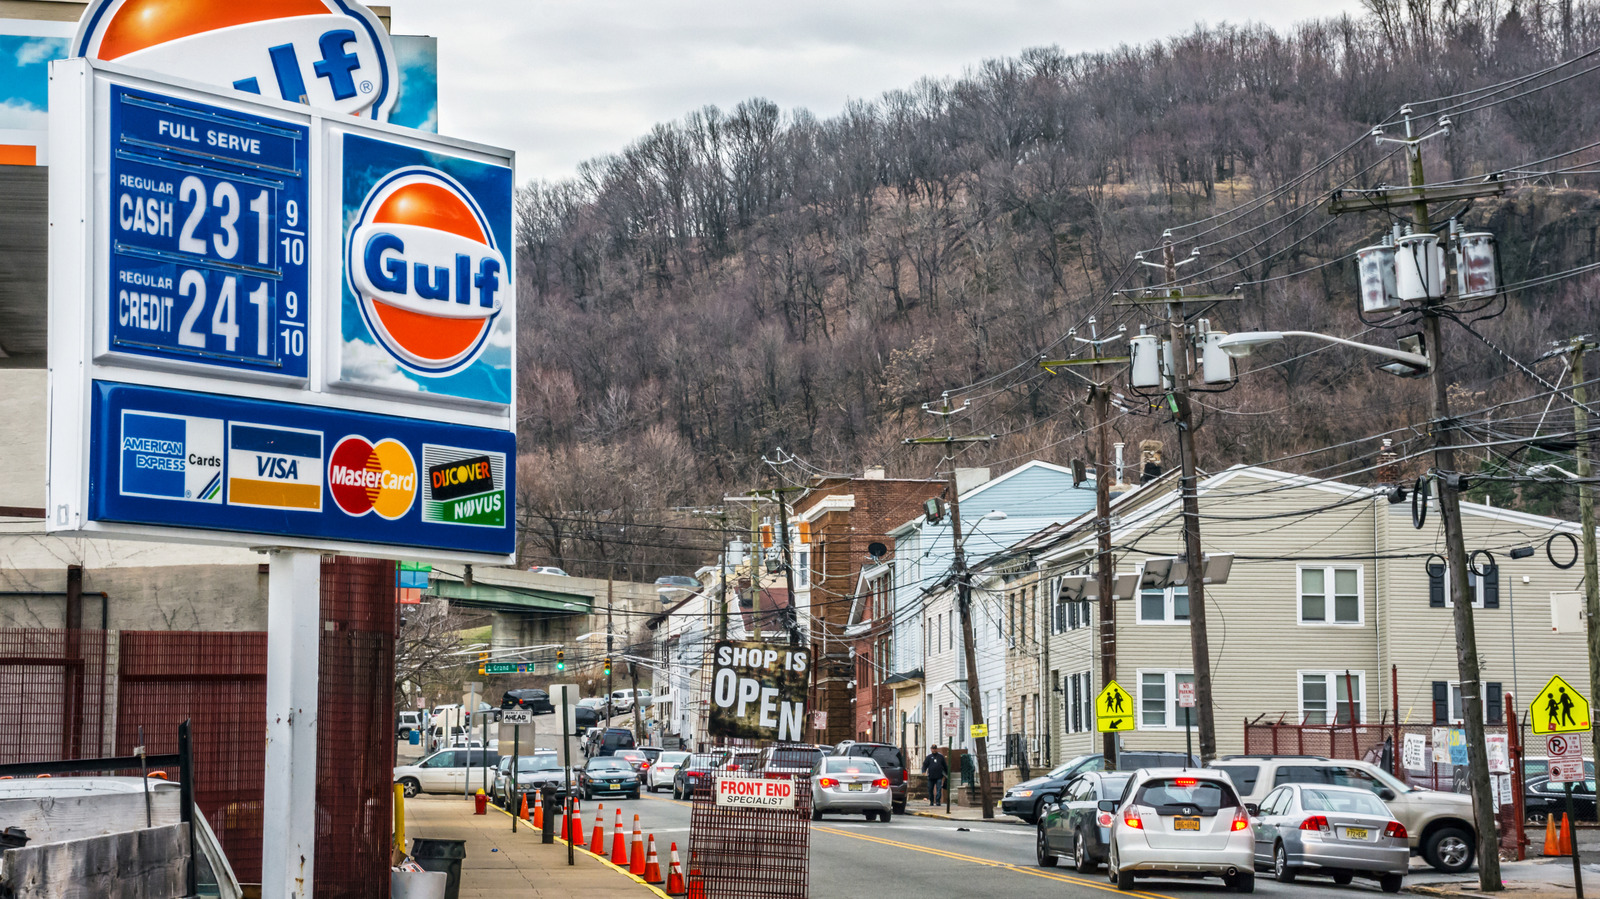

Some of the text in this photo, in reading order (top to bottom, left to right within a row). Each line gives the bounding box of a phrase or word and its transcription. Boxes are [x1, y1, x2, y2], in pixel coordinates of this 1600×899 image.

[233, 29, 361, 104] lf
[158, 119, 261, 155] FULL SERVE
[120, 174, 174, 195] REGULAR
[120, 193, 174, 238] CASH
[178, 175, 269, 265] 231
[119, 270, 173, 290] REGULAR
[363, 232, 500, 309] Gulf
[119, 289, 174, 332] CREDIT
[178, 269, 269, 356] 241
[123, 437, 183, 456] AMERICAN
[136, 454, 186, 472] EXPRESS
[188, 453, 221, 468] Cards
[256, 455, 299, 480] VISA
[332, 465, 414, 491] MasterCard
[432, 461, 490, 489] DISCOVER
[454, 493, 501, 520] NOVUS
[717, 646, 807, 671] SHOP IS
[714, 668, 803, 742] OPEN
[720, 781, 791, 797] FRONT END
[727, 795, 784, 805] SPECIALIST
